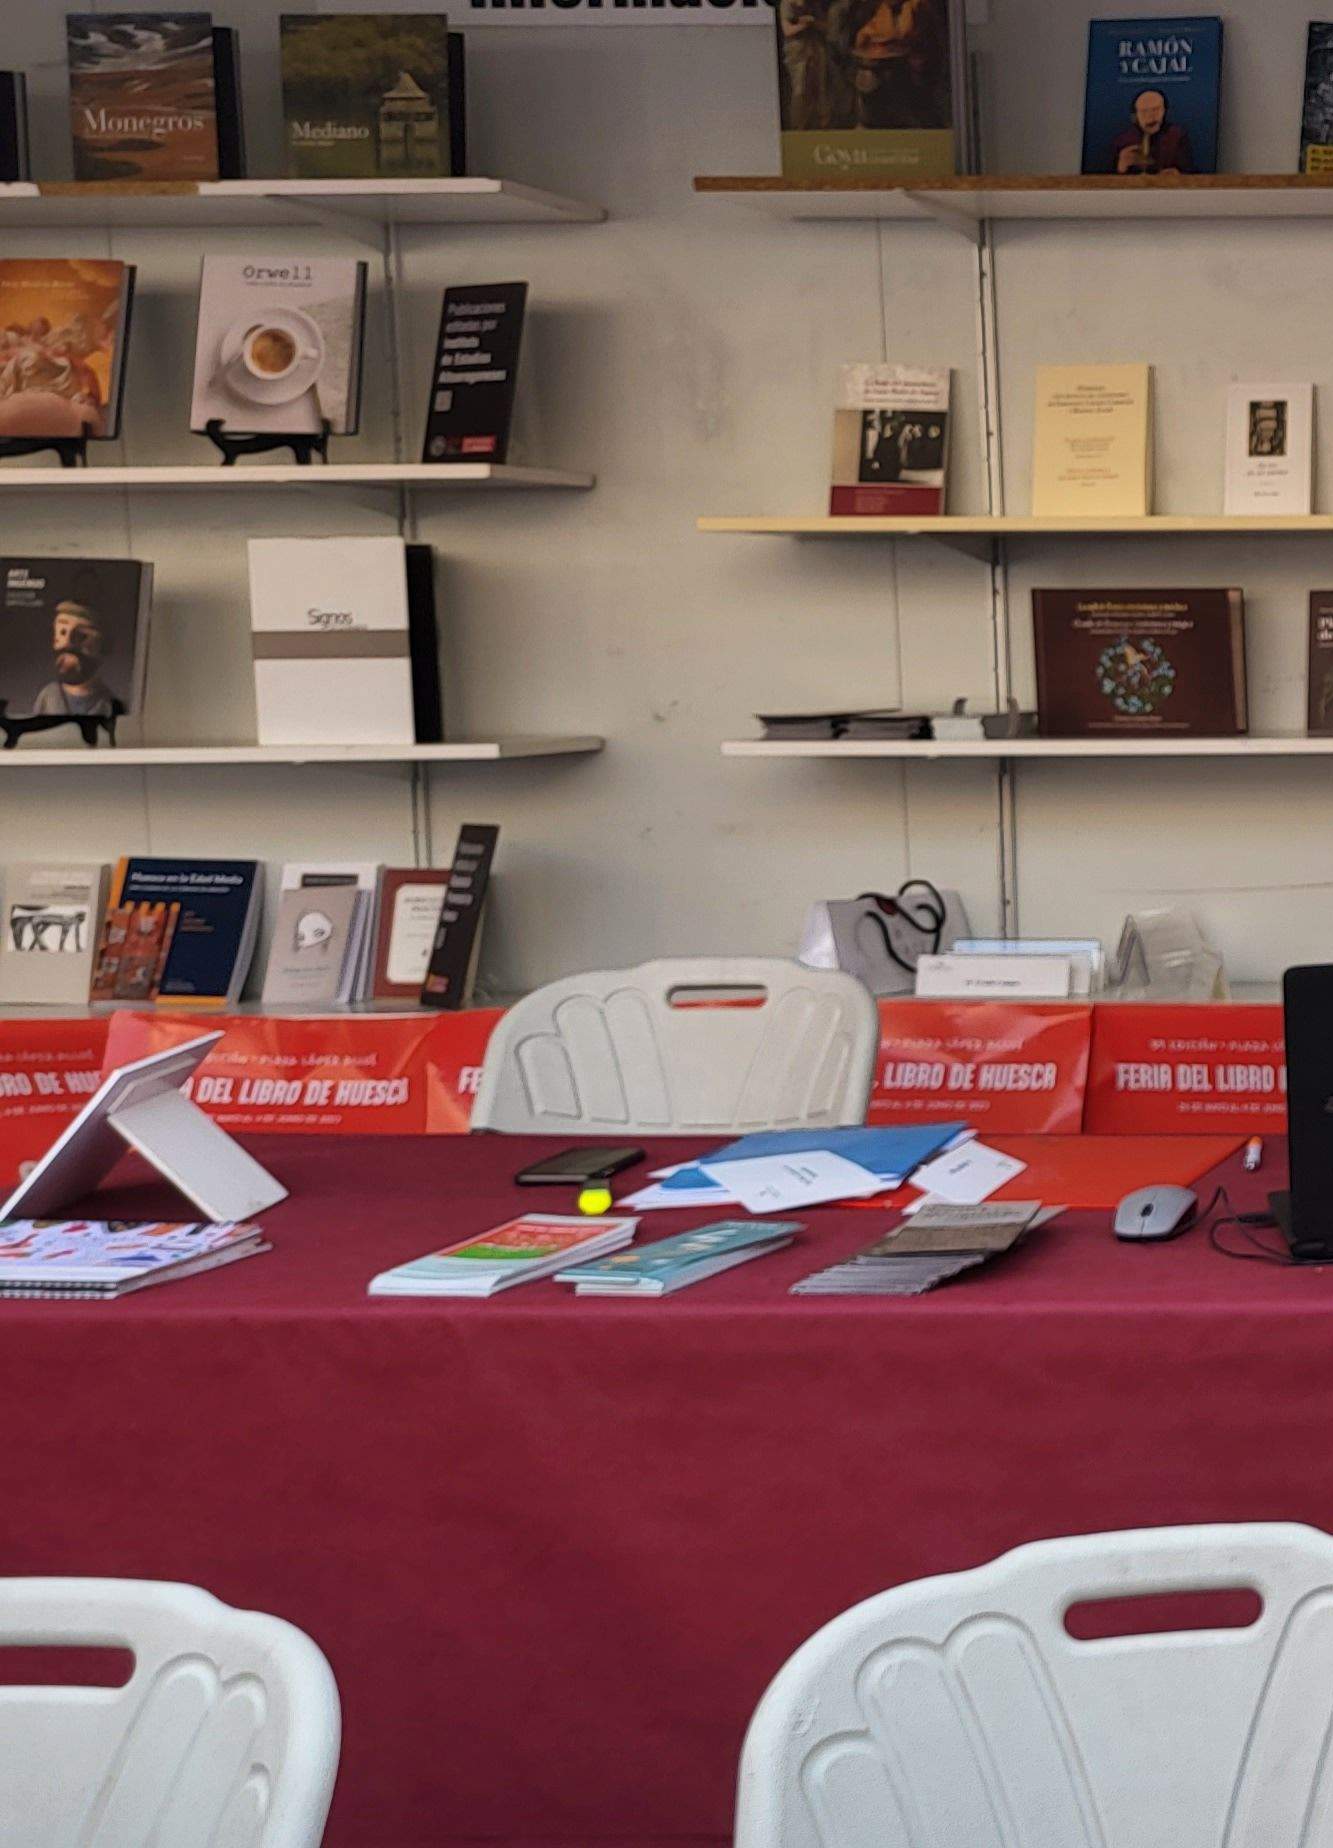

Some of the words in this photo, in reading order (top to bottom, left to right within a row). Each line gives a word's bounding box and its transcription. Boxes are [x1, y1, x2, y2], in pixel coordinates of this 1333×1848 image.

[1119, 34, 1192, 57] RAMÓN
[1131, 56, 1193, 74] CAJAL
[84, 108, 204, 137] Monegros
[242, 264, 312, 281] Orwell
[307, 607, 354, 630] Signos
[34, 1071, 64, 1095] DE
[883, 1061, 946, 1091] LIBRO
[947, 1062, 976, 1092] DE
[978, 1061, 1058, 1092] HUESCA
[1116, 1061, 1172, 1092] FERIA
[1175, 1063, 1212, 1093] DEL
[1215, 1064, 1275, 1093] LIBRO
[196, 1076, 234, 1104] DEL
[238, 1077, 303, 1106] LIBRO
[303, 1078, 335, 1107] DE
[334, 1076, 410, 1107] HUESCA
